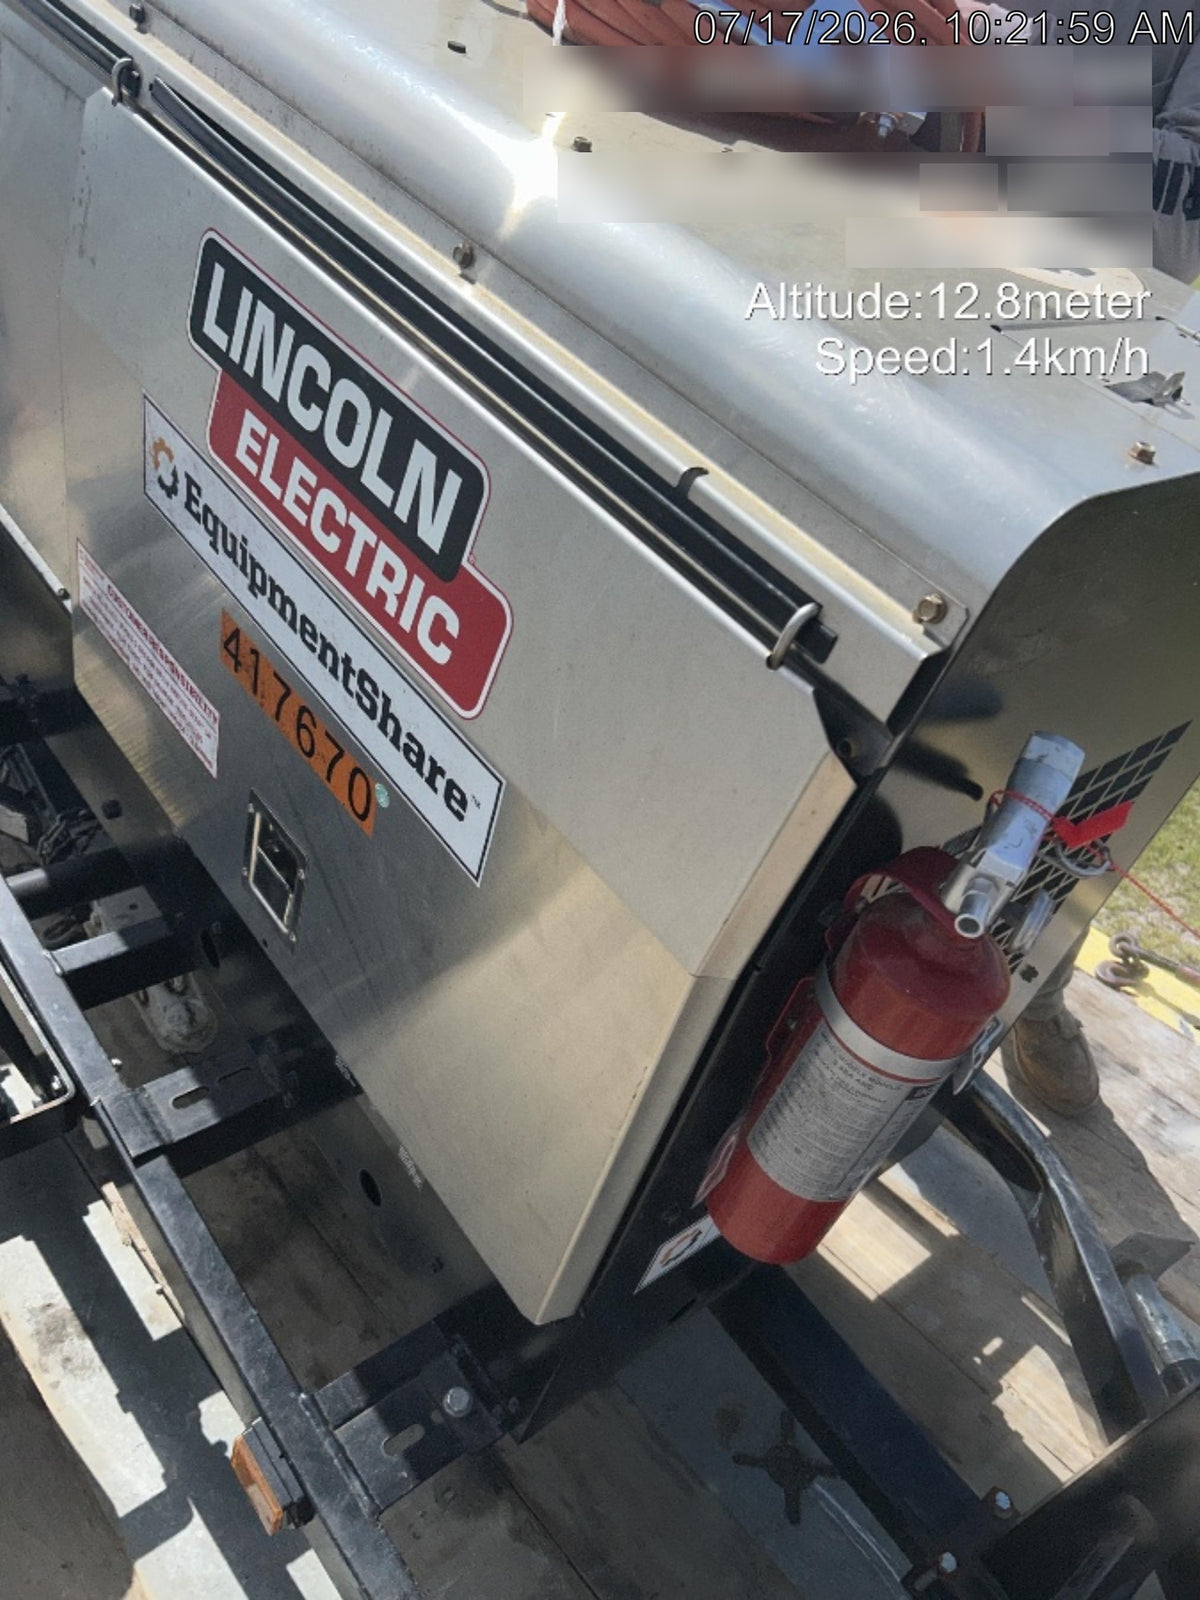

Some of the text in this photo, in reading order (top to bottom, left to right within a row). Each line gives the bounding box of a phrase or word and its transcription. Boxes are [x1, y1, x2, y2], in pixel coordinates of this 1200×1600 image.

[202, 261, 463, 556] LINCOLN
[234, 408, 461, 666] ELECTRIC
[183, 471, 468, 822] EquipmentShare
[222, 627, 372, 824] 417670
